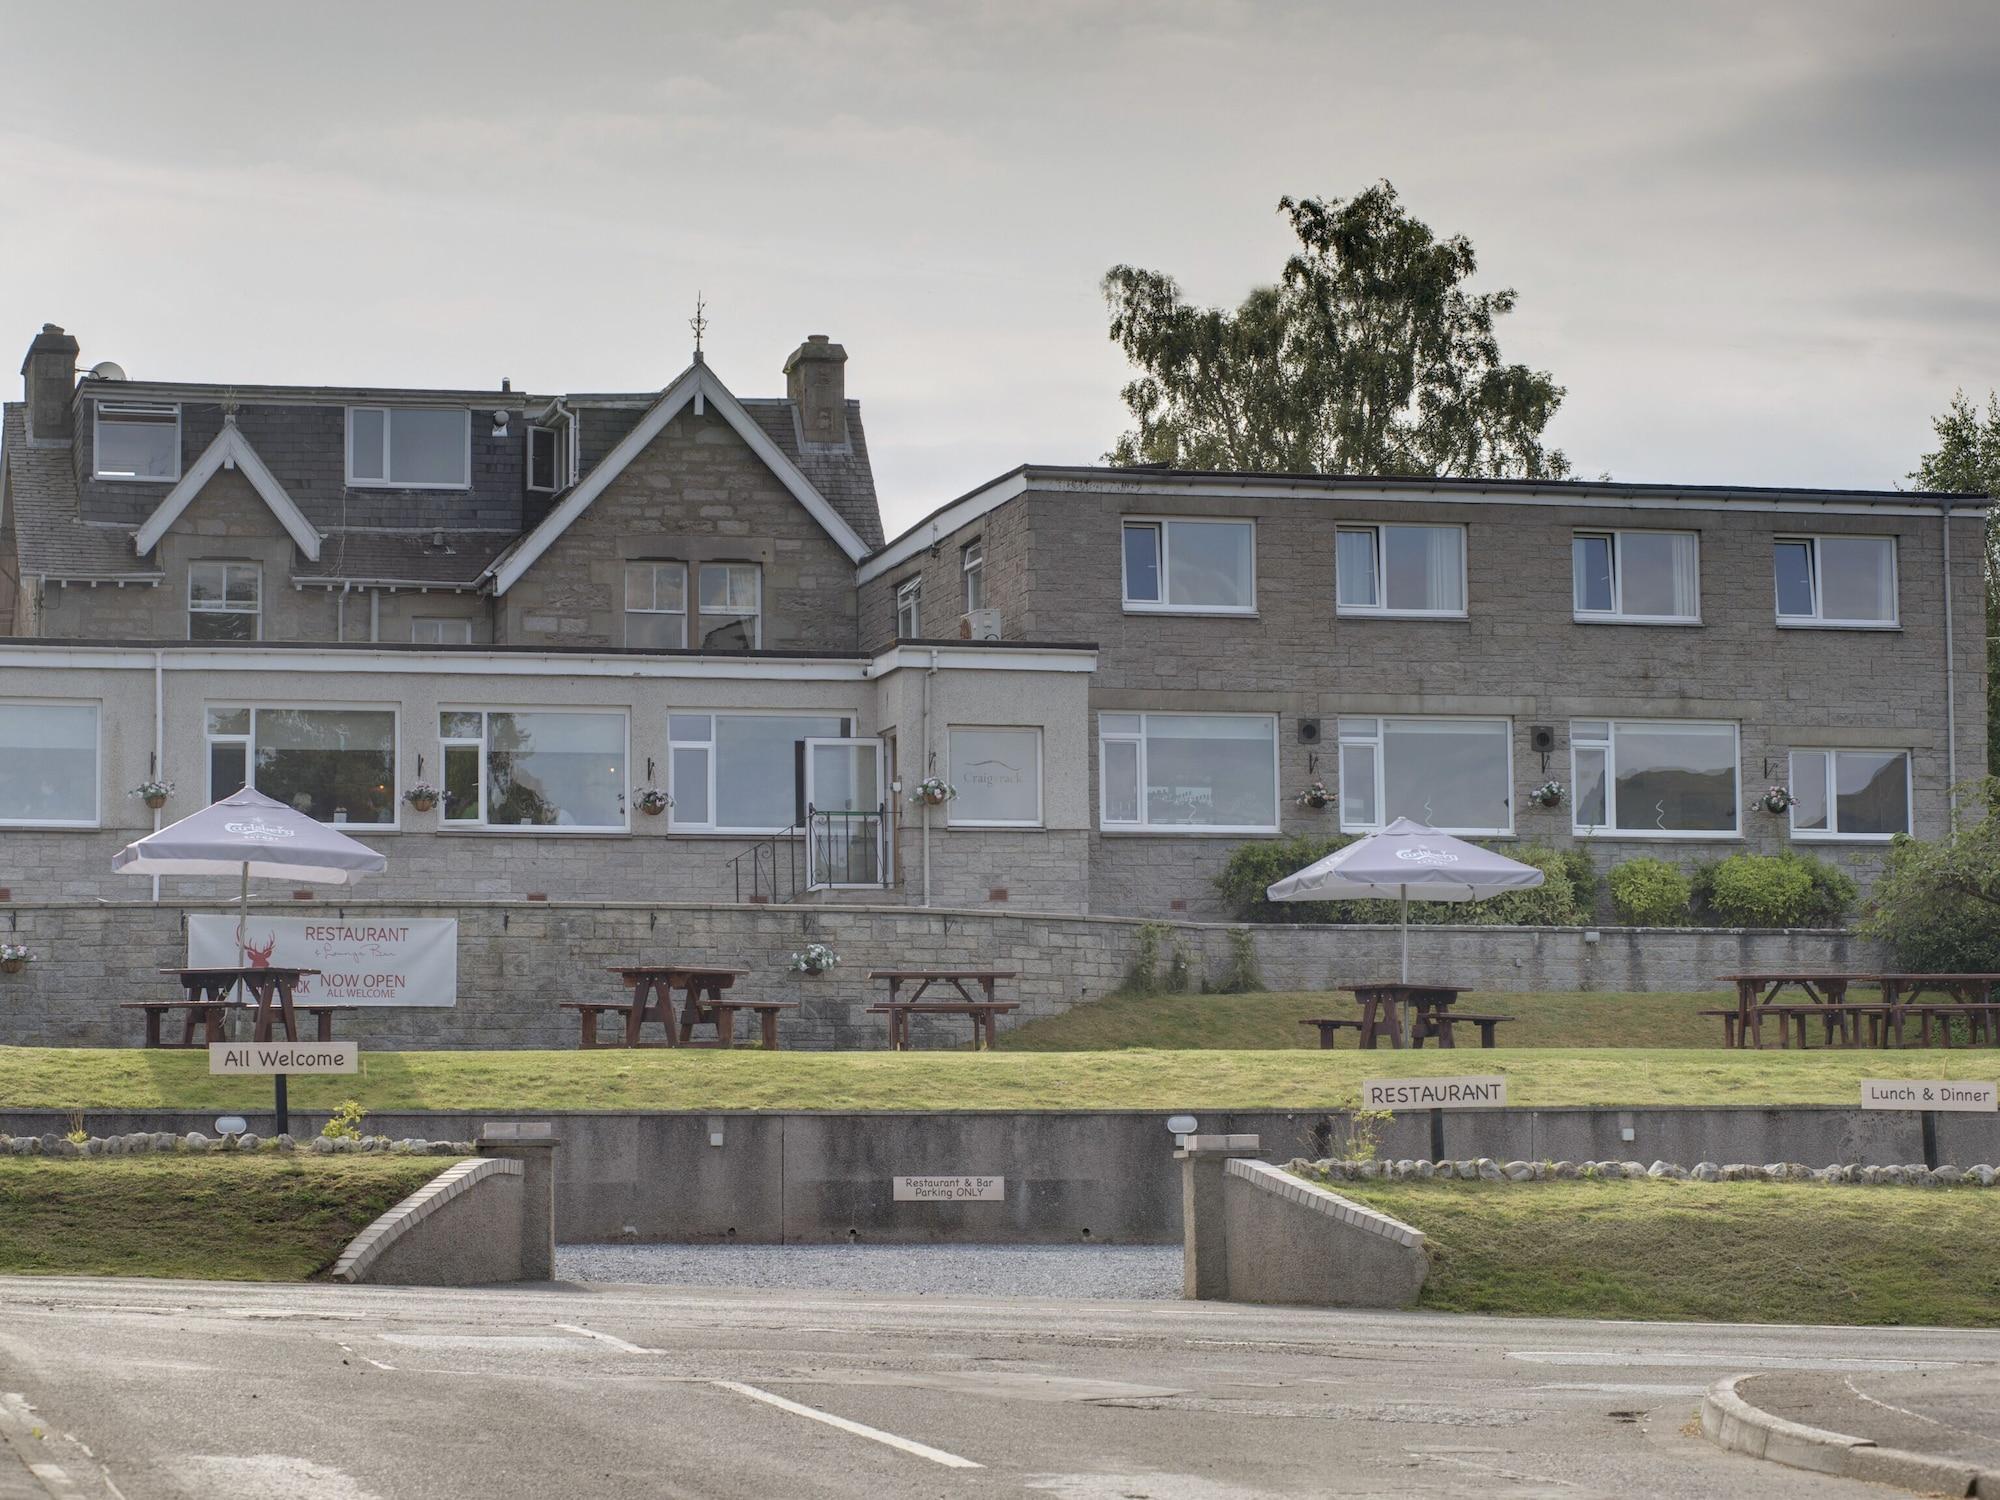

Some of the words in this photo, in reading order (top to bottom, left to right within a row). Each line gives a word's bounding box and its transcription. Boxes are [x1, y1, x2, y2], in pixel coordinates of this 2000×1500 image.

[305, 926, 409, 942] RESTAURANT
[320, 973, 360, 988] NOW
[363, 974, 406, 988] OPEN
[326, 988, 345, 998] ALL
[347, 988, 396, 998] WELCOME
[224, 1050, 250, 1067] All
[258, 1050, 345, 1067] Welcome
[1371, 1083, 1502, 1104] RESTAURANT
[1871, 1086, 1916, 1101] Lunch
[1922, 1087, 1934, 1101] &
[1940, 1088, 1990, 1102] Dinner
[905, 1178, 960, 1188] Restaurant
[964, 1178, 972, 1188] &
[976, 1178, 993, 1188] Bar
[915, 1187, 953, 1200] Parking
[956, 1187, 984, 1197] ONLY
